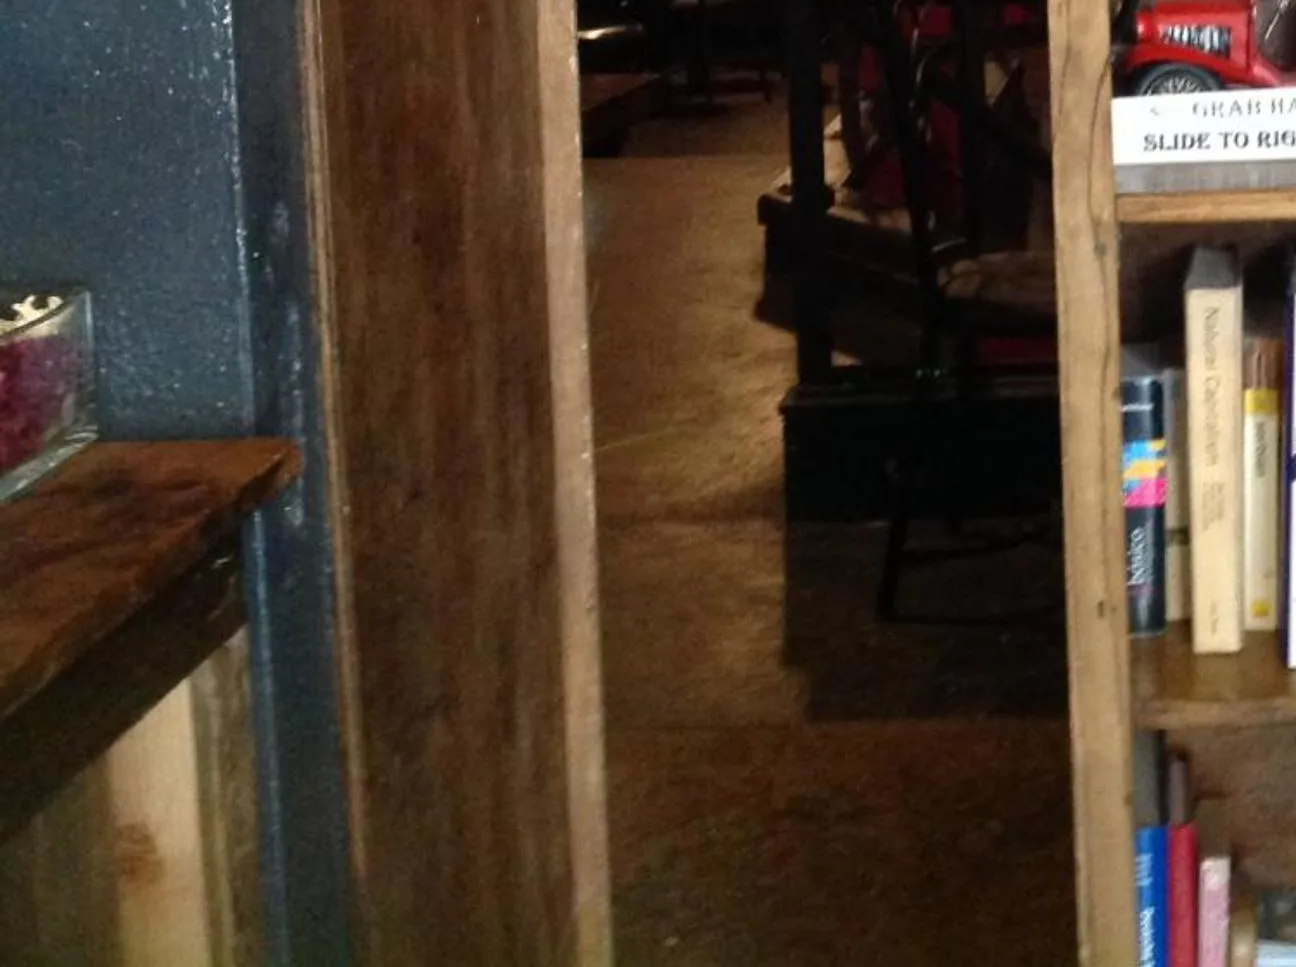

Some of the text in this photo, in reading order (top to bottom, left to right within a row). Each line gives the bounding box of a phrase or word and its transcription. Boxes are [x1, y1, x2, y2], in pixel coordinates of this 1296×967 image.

[1191, 99, 1262, 118] GRAB
[1142, 132, 1212, 152] SLIDE
[1218, 130, 1250, 150] TO
[1201, 305, 1221, 371] Natural
[1202, 375, 1221, 468] Capitalism
